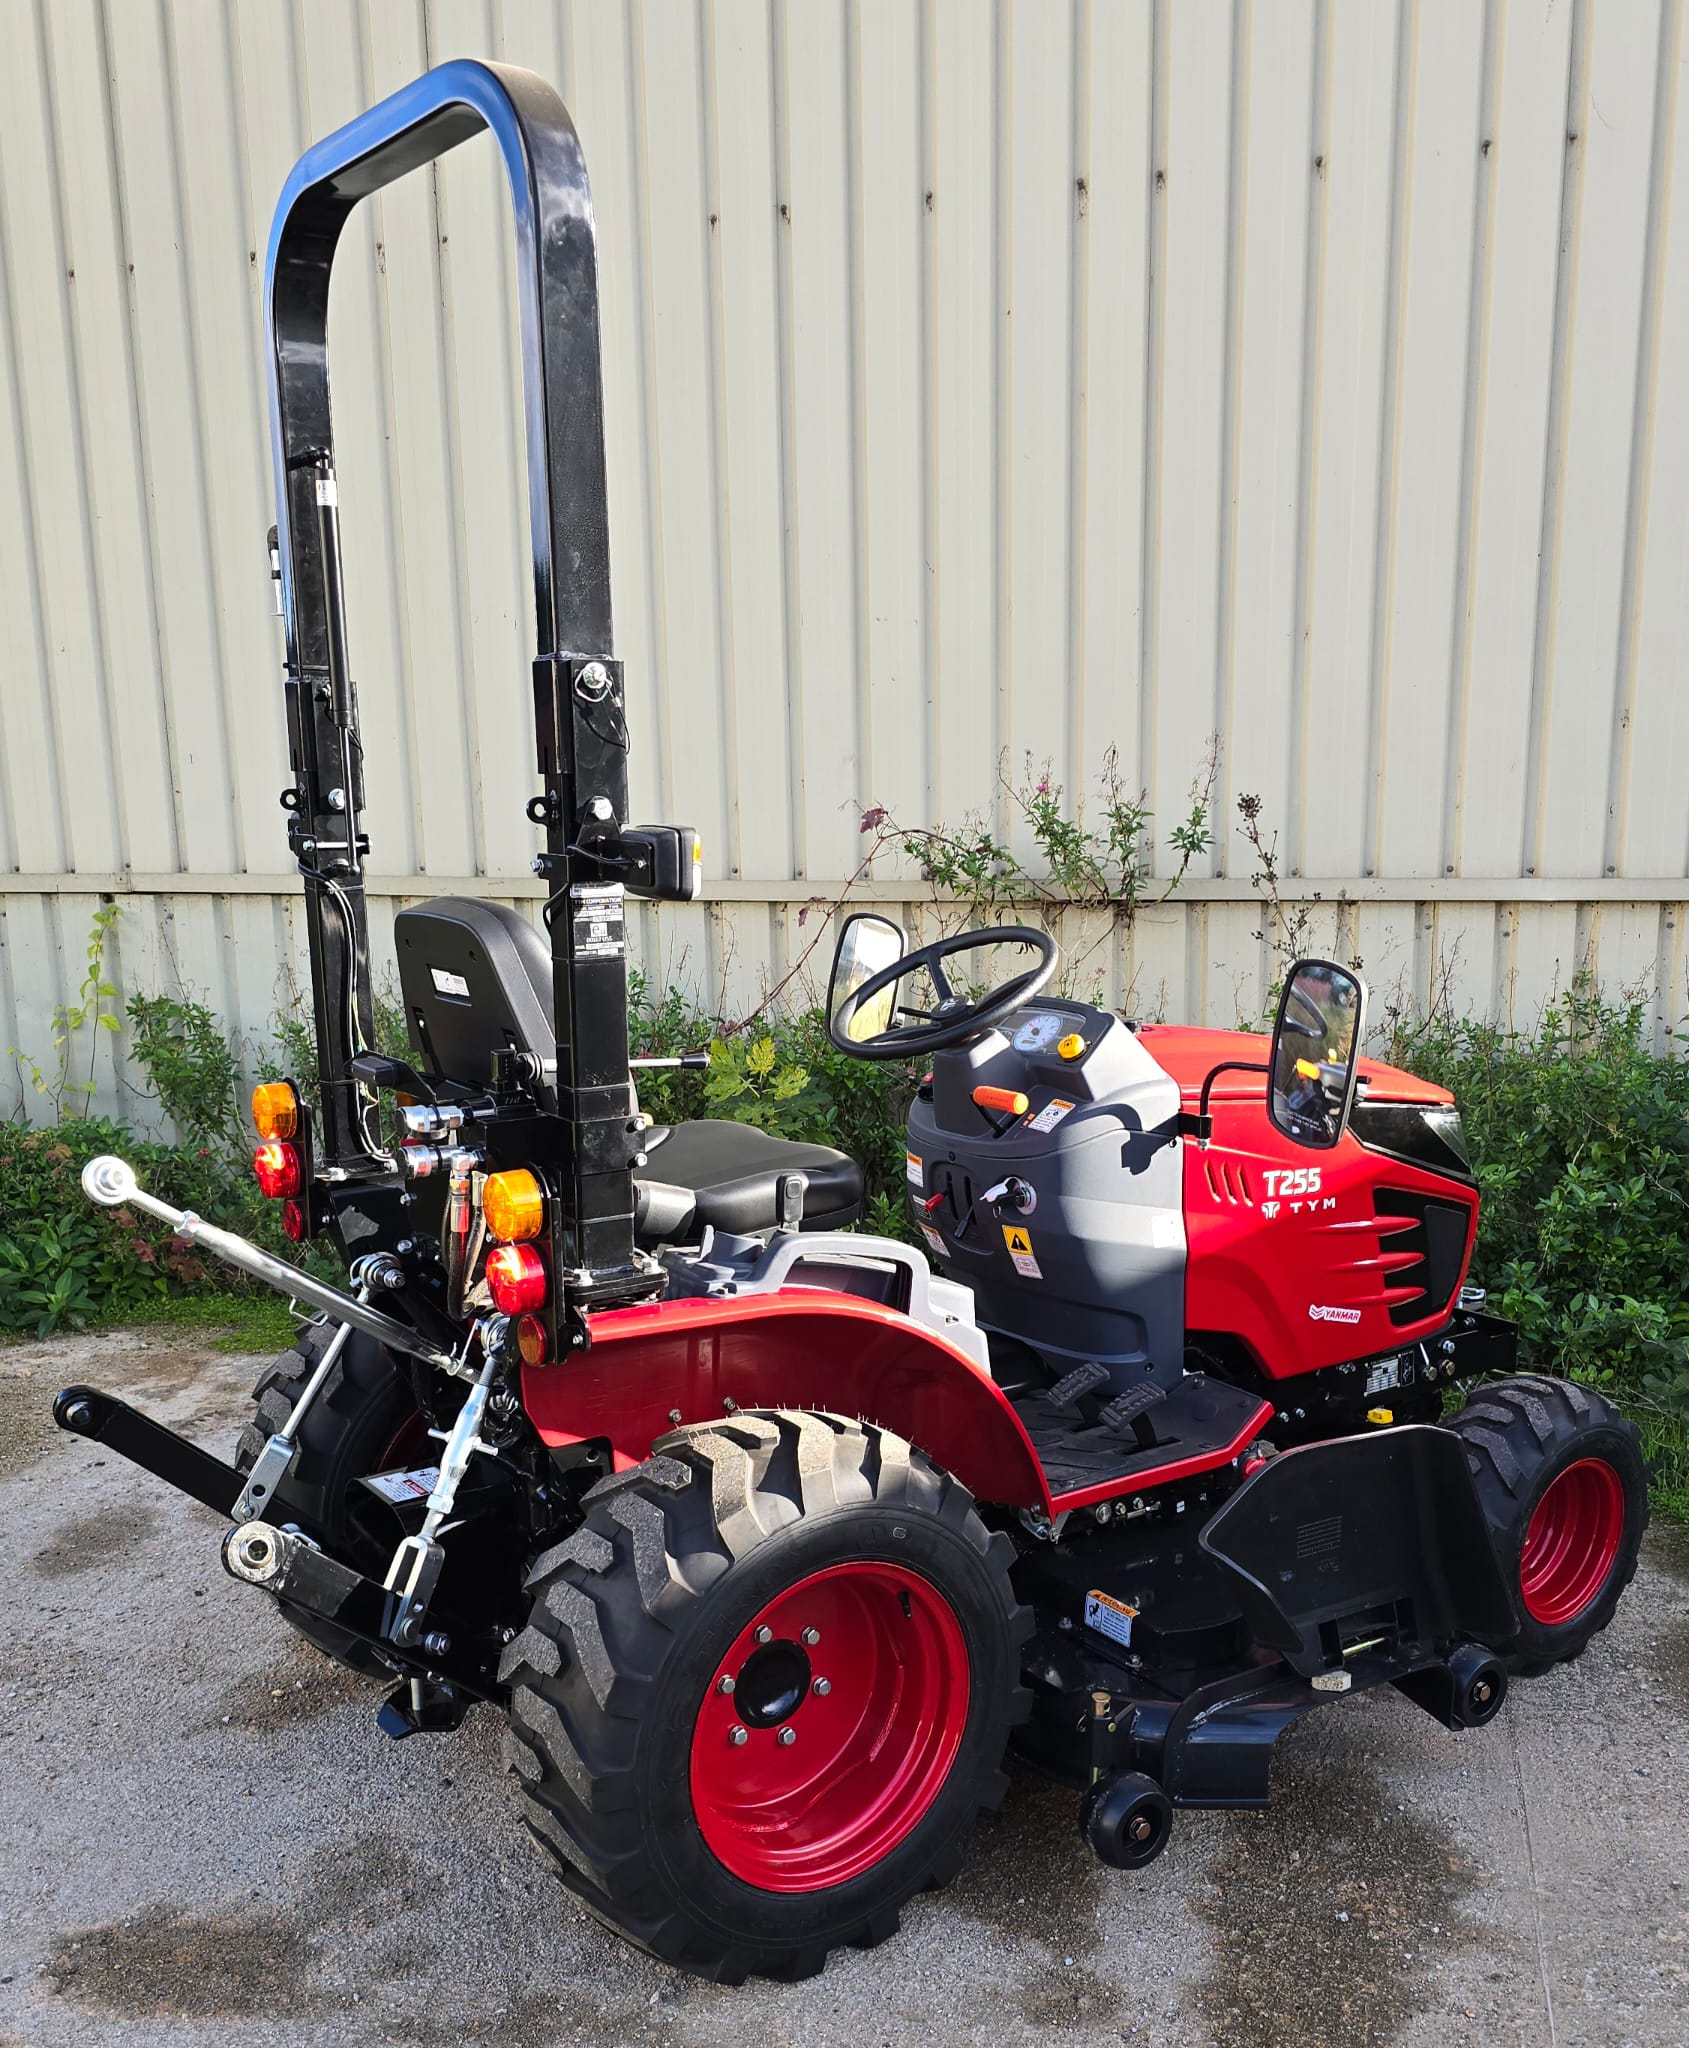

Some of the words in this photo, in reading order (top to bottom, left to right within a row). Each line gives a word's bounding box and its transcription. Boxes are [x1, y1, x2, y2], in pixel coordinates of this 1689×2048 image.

[1263, 1168, 1321, 1197] T255
[1290, 1197, 1336, 1213] TYM
[1325, 1309, 1359, 1321] YANMAR
